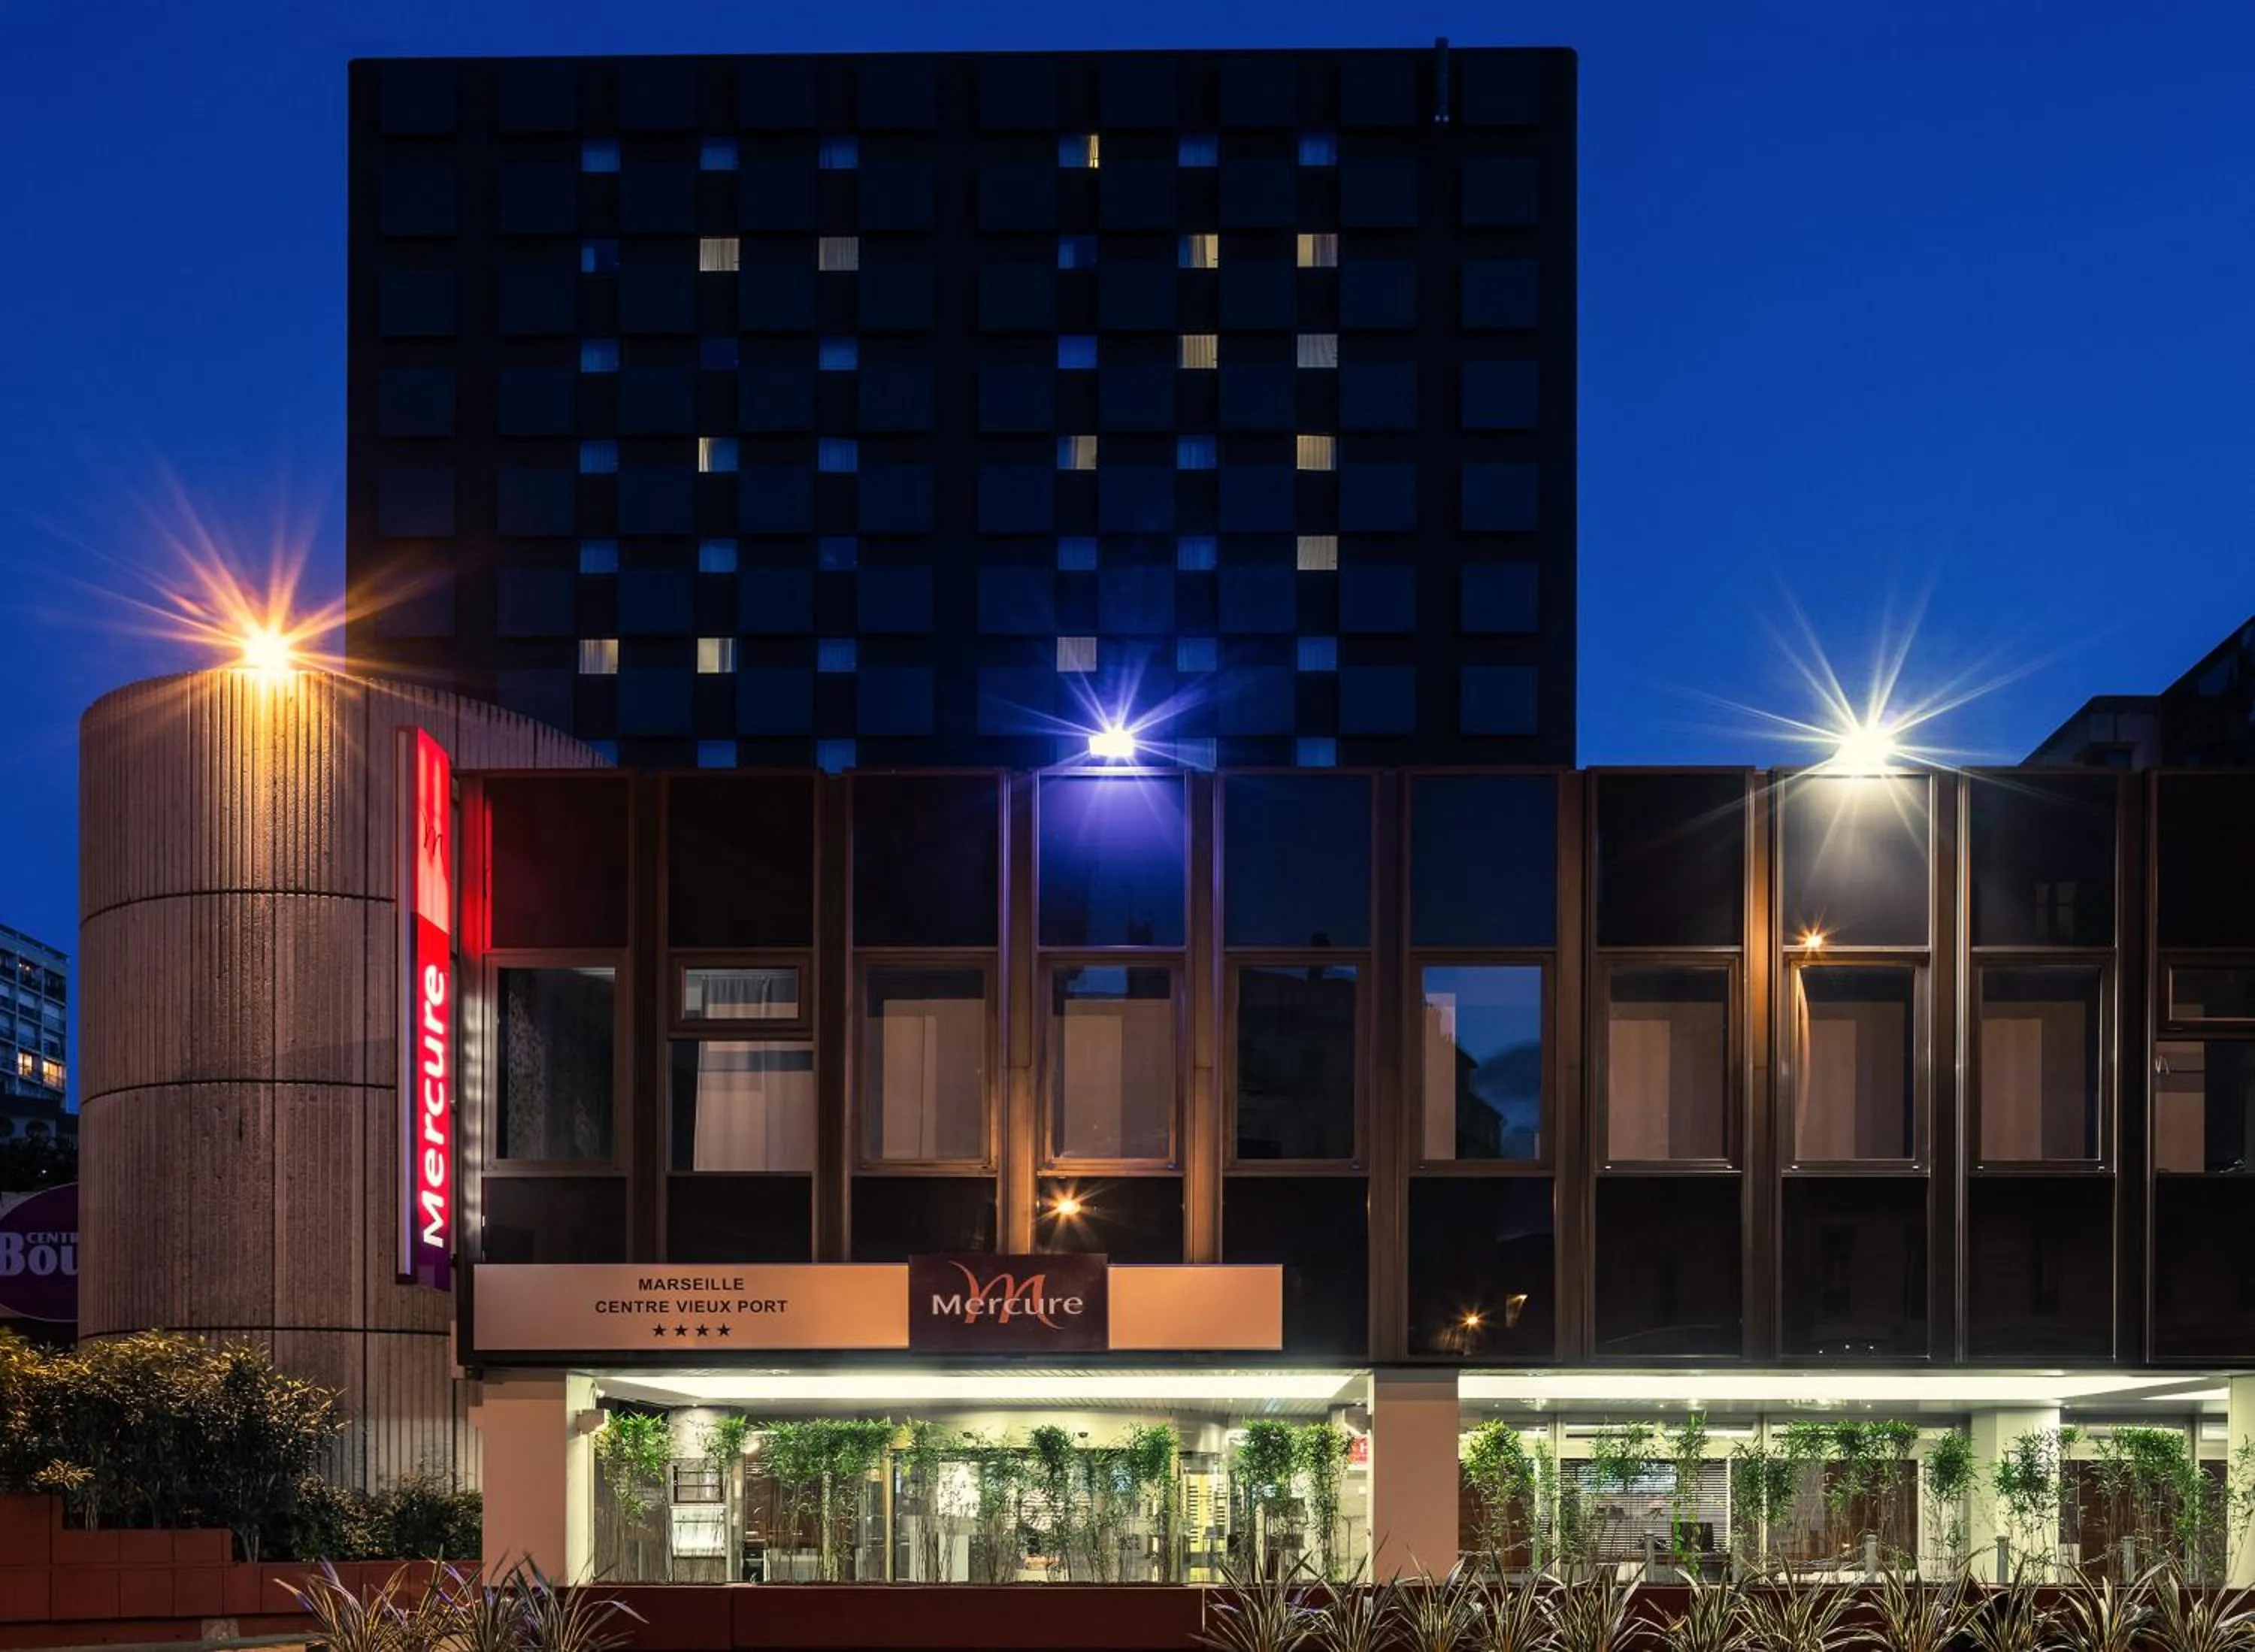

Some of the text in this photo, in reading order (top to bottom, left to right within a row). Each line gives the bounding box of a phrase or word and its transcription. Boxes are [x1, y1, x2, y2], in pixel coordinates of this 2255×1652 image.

[421, 964, 445, 1248] Mercure
[639, 1278, 744, 1290] MARSEILLE
[595, 1300, 788, 1313] CENTRE VIEUX PORT
[932, 1294, 1083, 1315] Mercure
